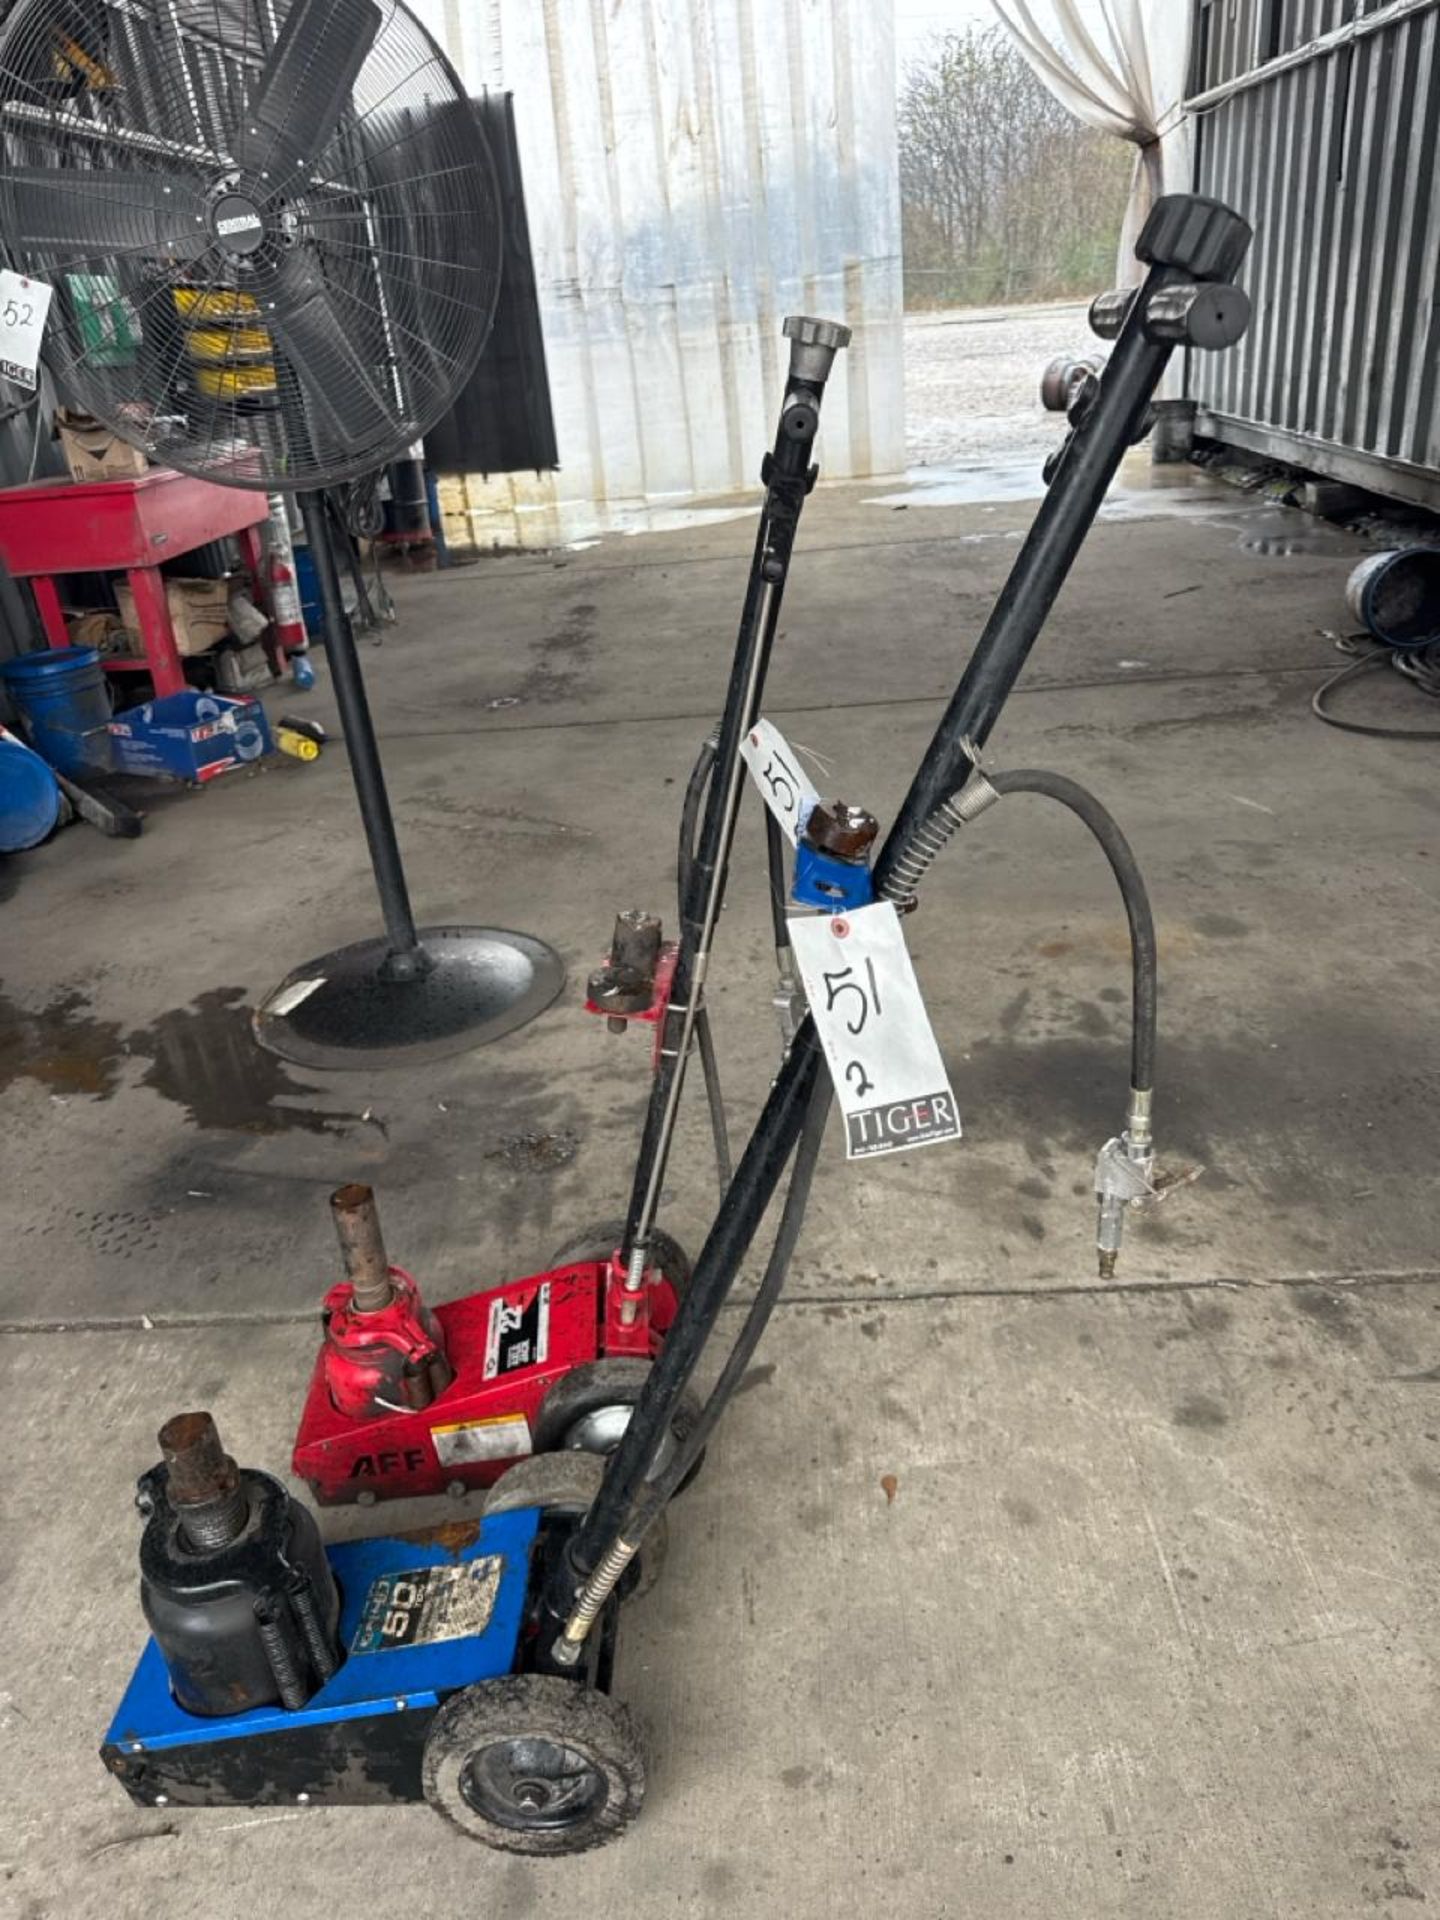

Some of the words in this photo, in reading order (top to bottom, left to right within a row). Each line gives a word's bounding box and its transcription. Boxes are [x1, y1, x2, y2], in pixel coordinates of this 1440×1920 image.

[3, 299, 34, 327] 52
[763, 750, 800, 812] 51
[822, 957, 881, 1036] 51
[845, 1060, 875, 1097] 2
[848, 1097, 954, 1142] TIGER
[500, 1305, 523, 1334] 22
[349, 1449, 425, 1479] AFF
[381, 1581, 418, 1638] 50
